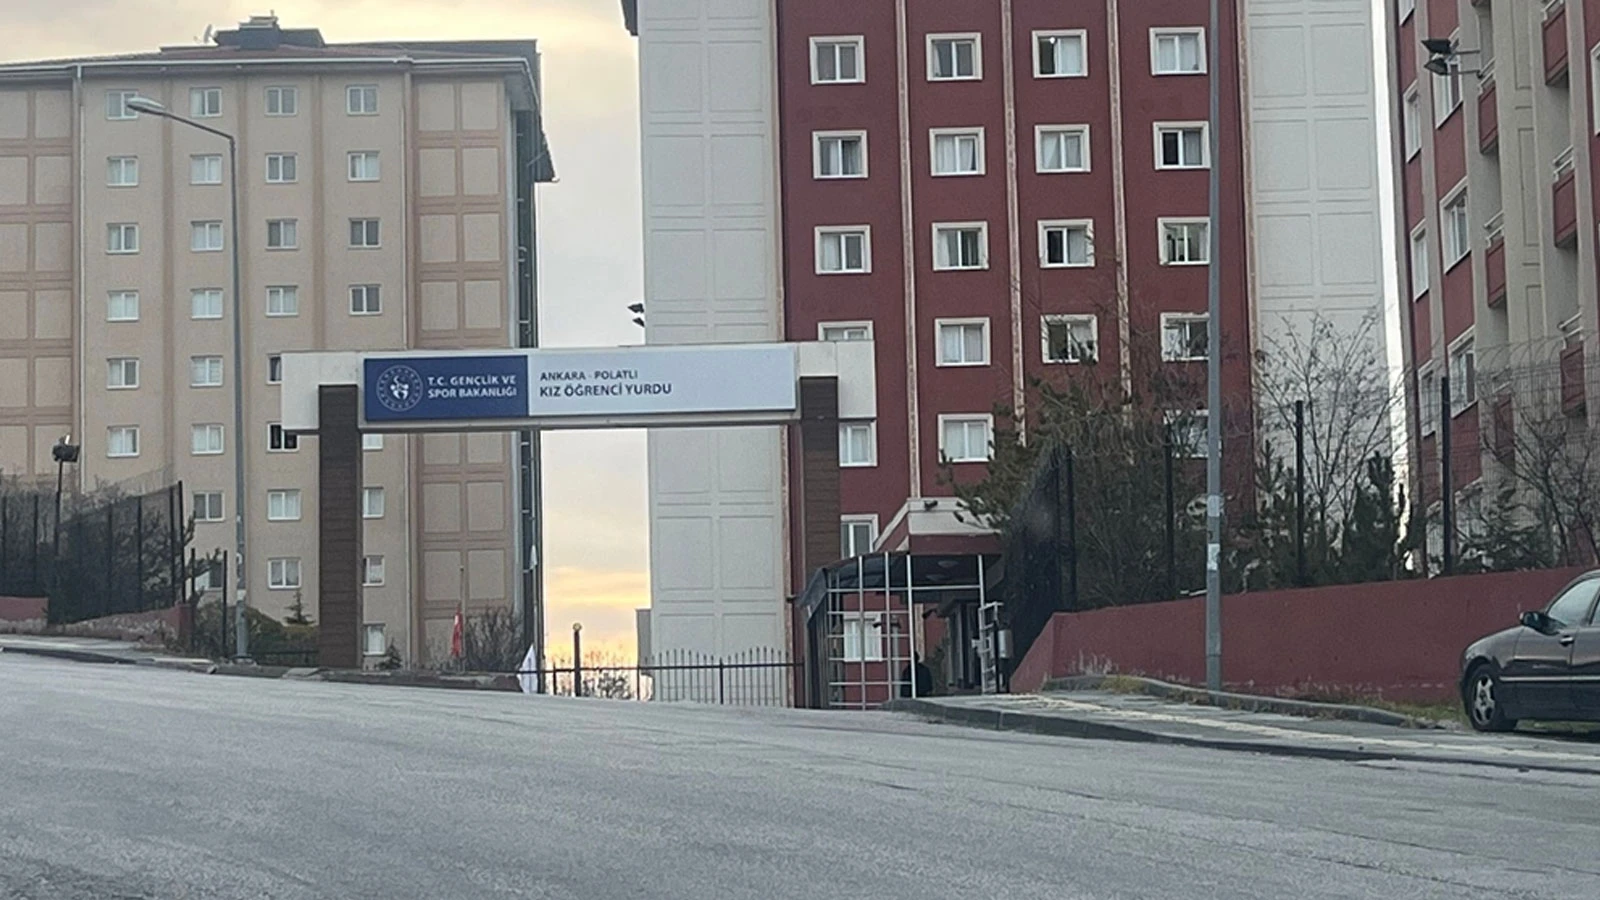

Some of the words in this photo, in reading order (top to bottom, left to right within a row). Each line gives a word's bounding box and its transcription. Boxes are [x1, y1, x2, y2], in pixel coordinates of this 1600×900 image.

[428, 376, 448, 387] T.C.
[450, 374, 498, 387] GENÇLİK
[501, 375, 516, 385] VE
[540, 371, 586, 381] ANKARA
[594, 369, 638, 380] POLATLI
[428, 387, 456, 398] SPOR
[459, 386, 517, 398] BAKANLIĞI
[540, 386, 561, 397] KIZ
[564, 382, 622, 397] ÖĞRENCİ
[625, 383, 672, 395] YURDU
